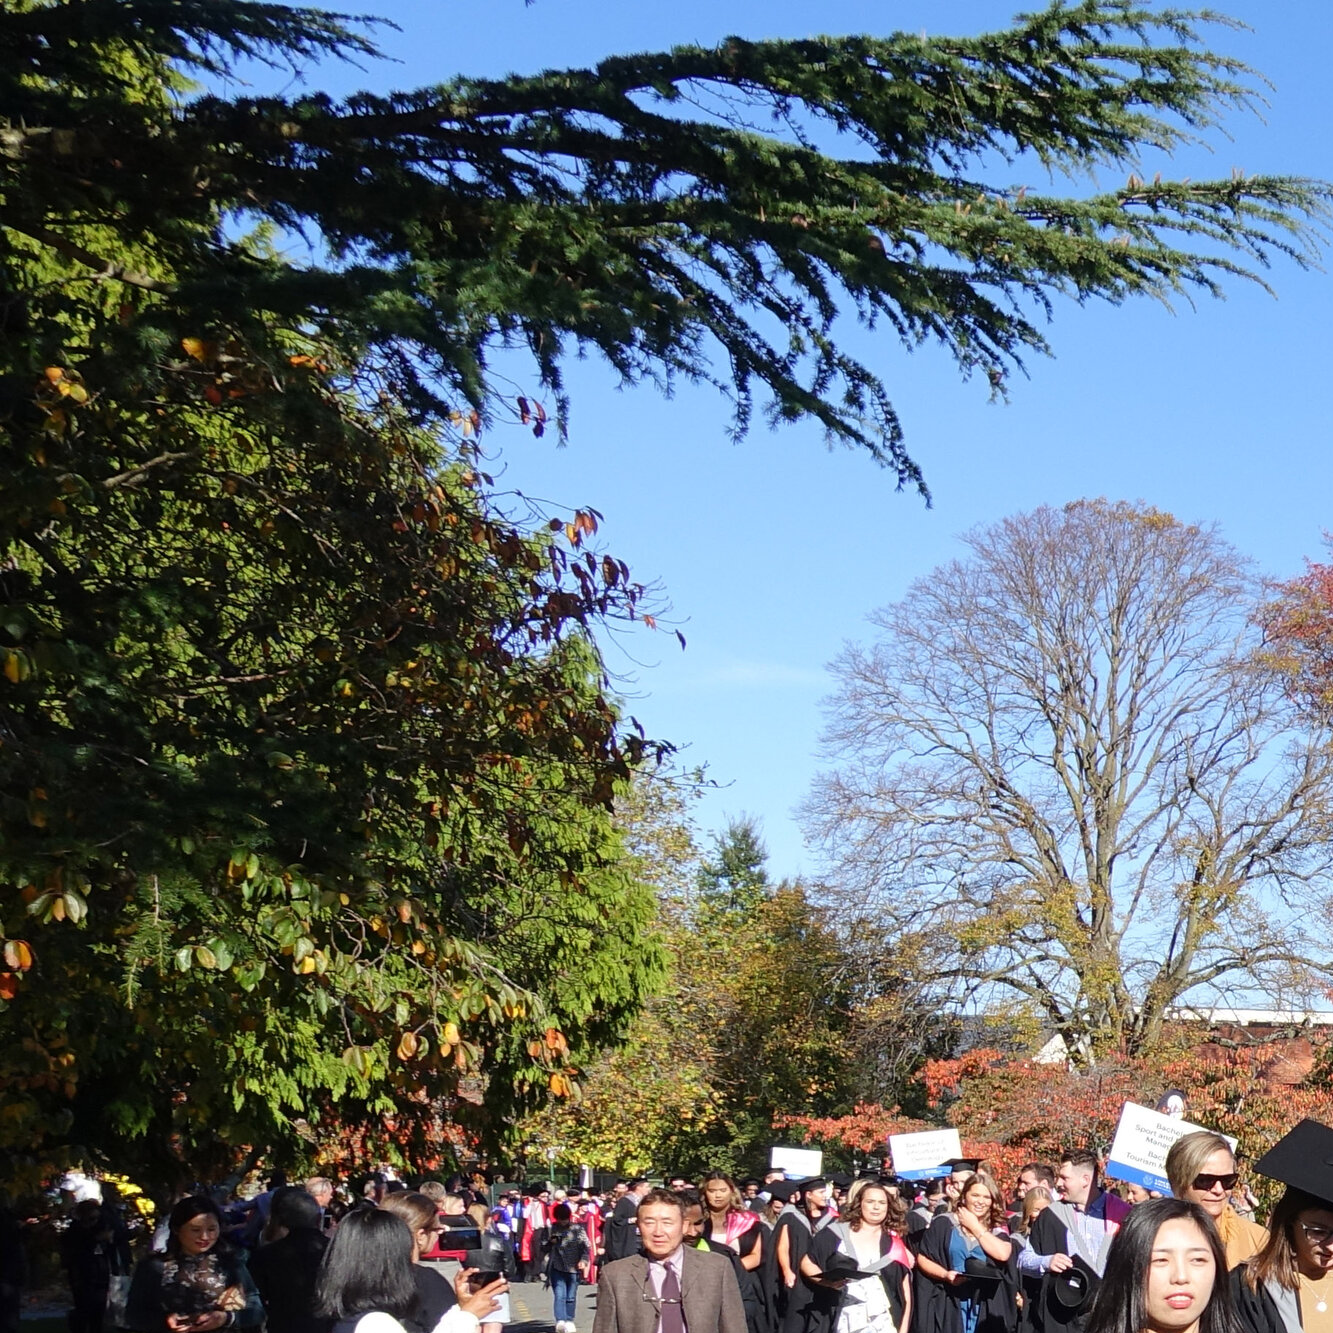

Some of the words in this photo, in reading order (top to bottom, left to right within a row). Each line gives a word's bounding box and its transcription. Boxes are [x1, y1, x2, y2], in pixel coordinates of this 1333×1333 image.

[1135, 1124, 1157, 1137] Sport
[1158, 1133, 1173, 1142] and
[1156, 1123, 1183, 1136] Bachel
[1126, 1152, 1157, 1167] Tourism
[1148, 1150, 1167, 1162] Bach
